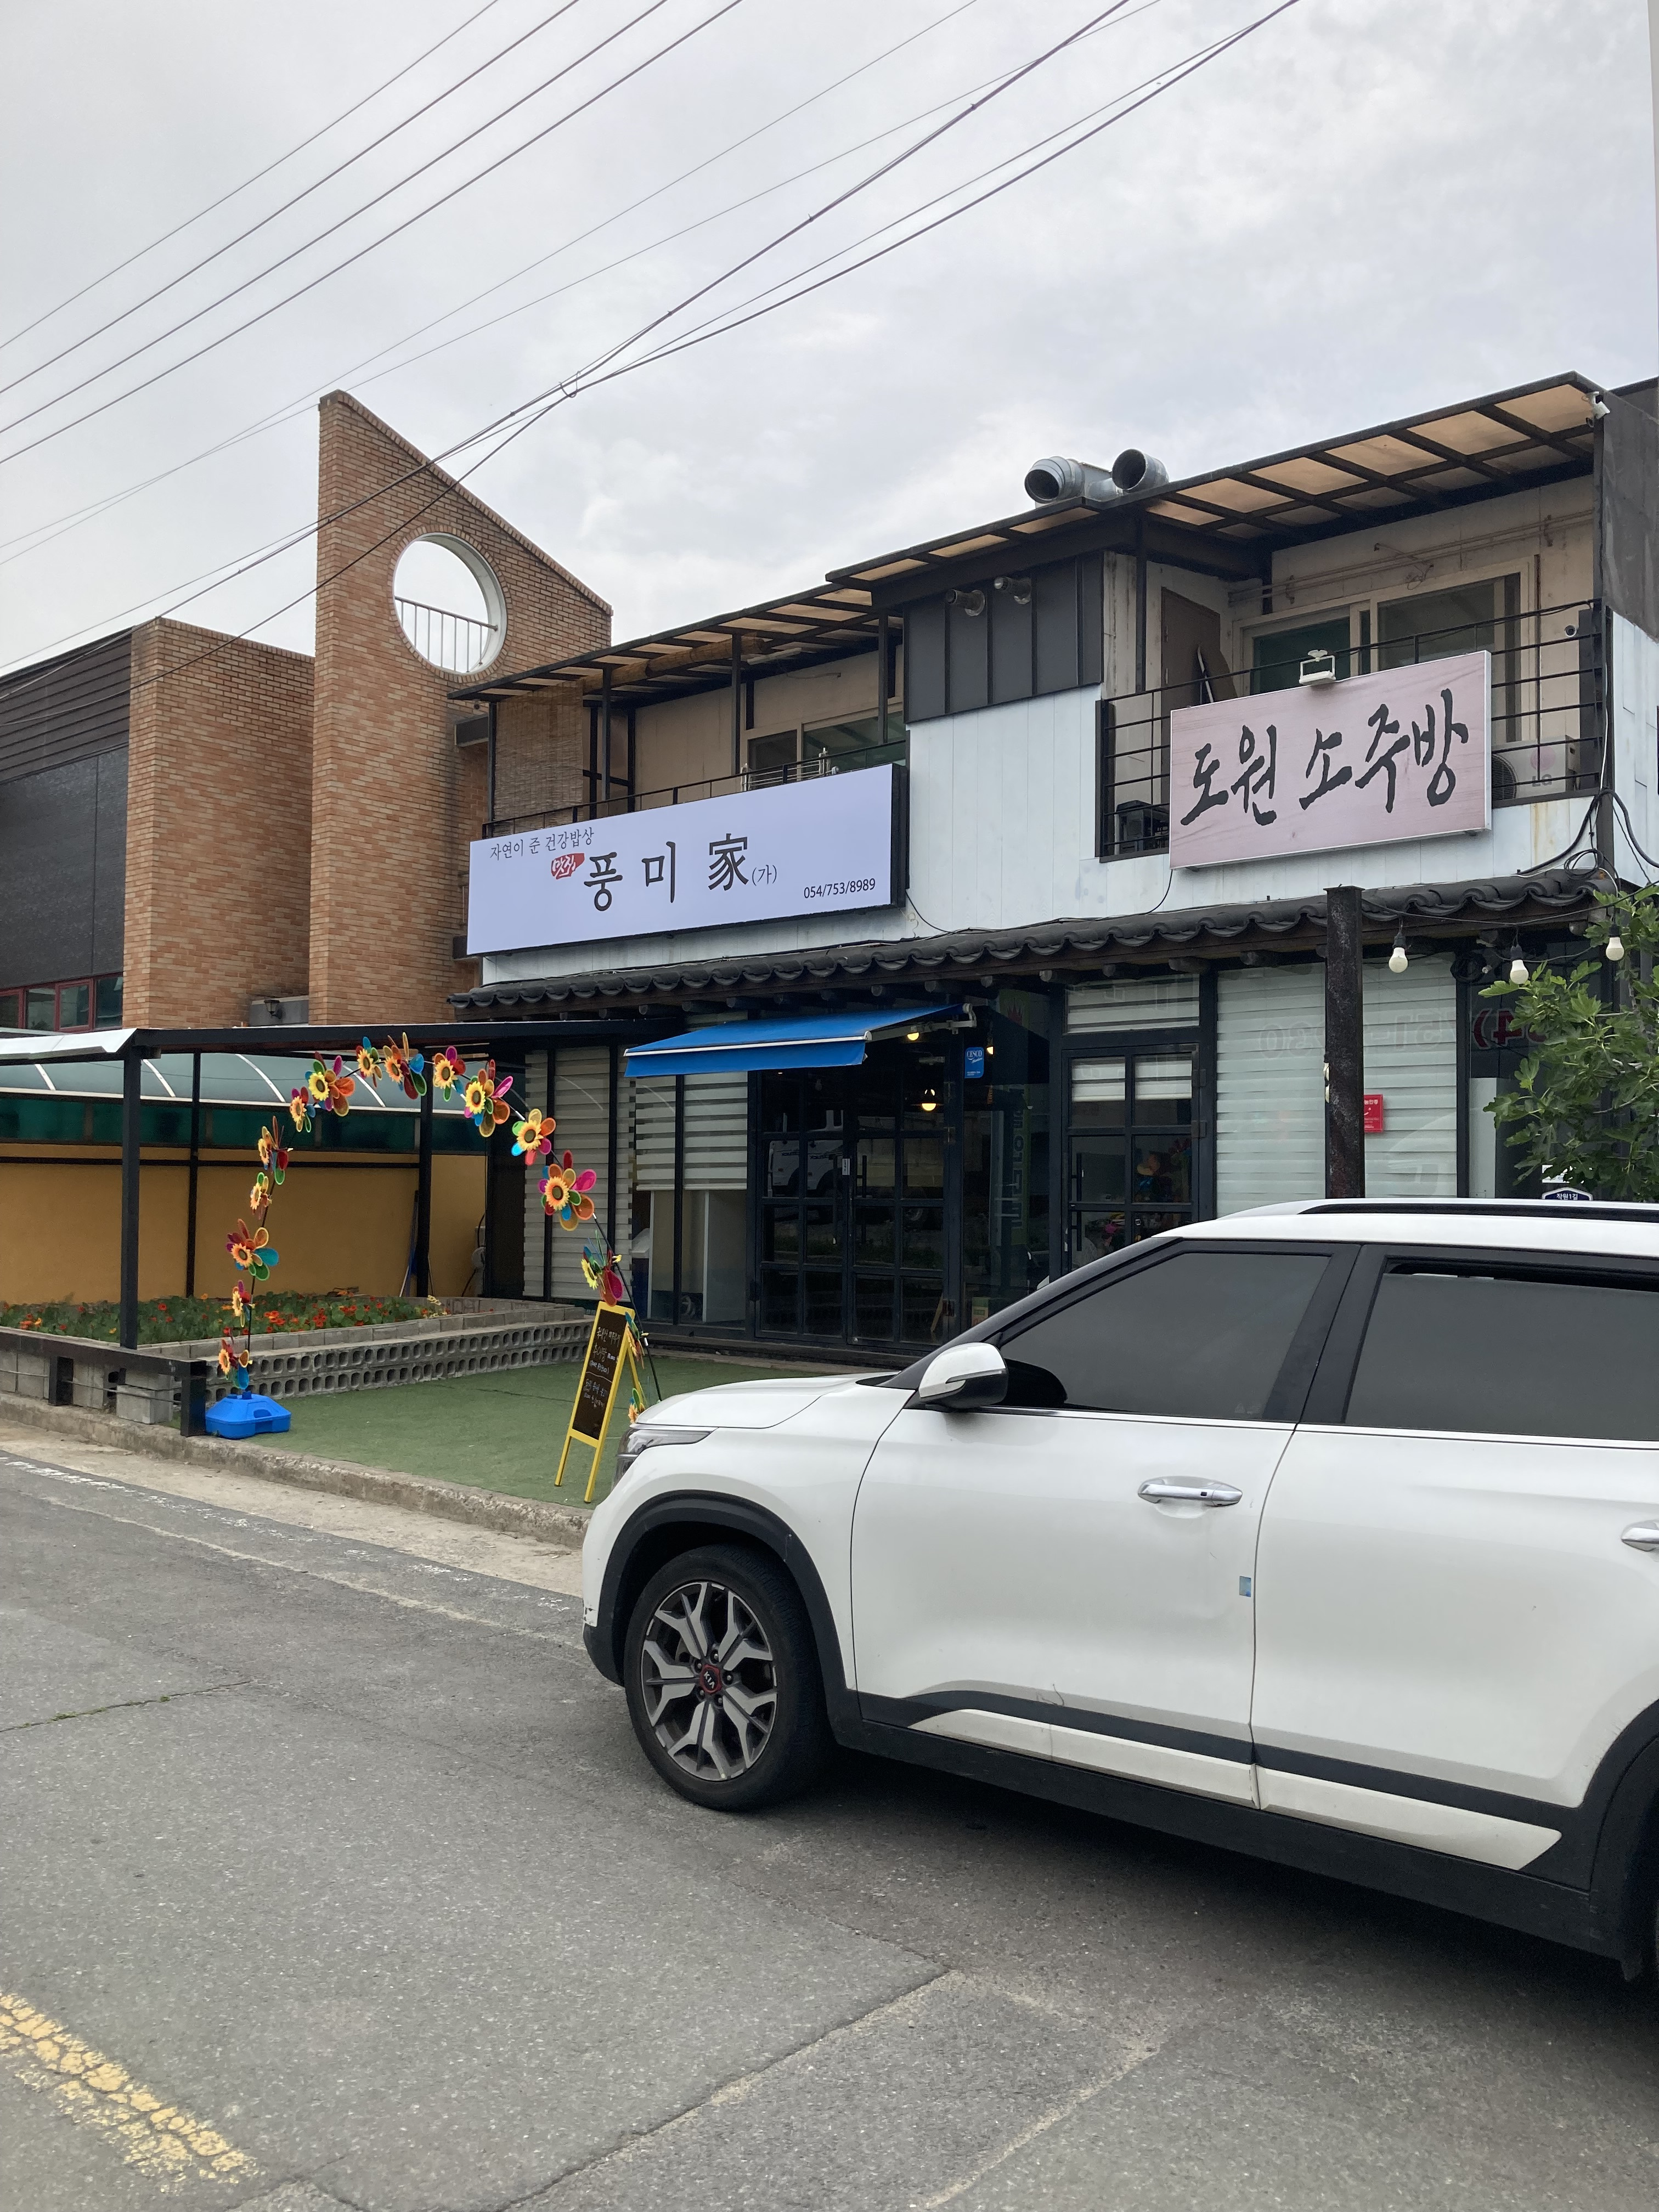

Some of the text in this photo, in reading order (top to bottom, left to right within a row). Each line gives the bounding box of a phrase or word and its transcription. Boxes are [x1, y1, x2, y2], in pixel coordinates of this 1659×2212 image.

[1180, 688, 1469, 826] 도원 소주방
[1532, 774, 1552, 787] LG
[489, 827, 595, 861] 자연이 준 건강밥상
[803, 878, 876, 899] 054/753/8989
[704, 1671, 715, 1689] KIA
